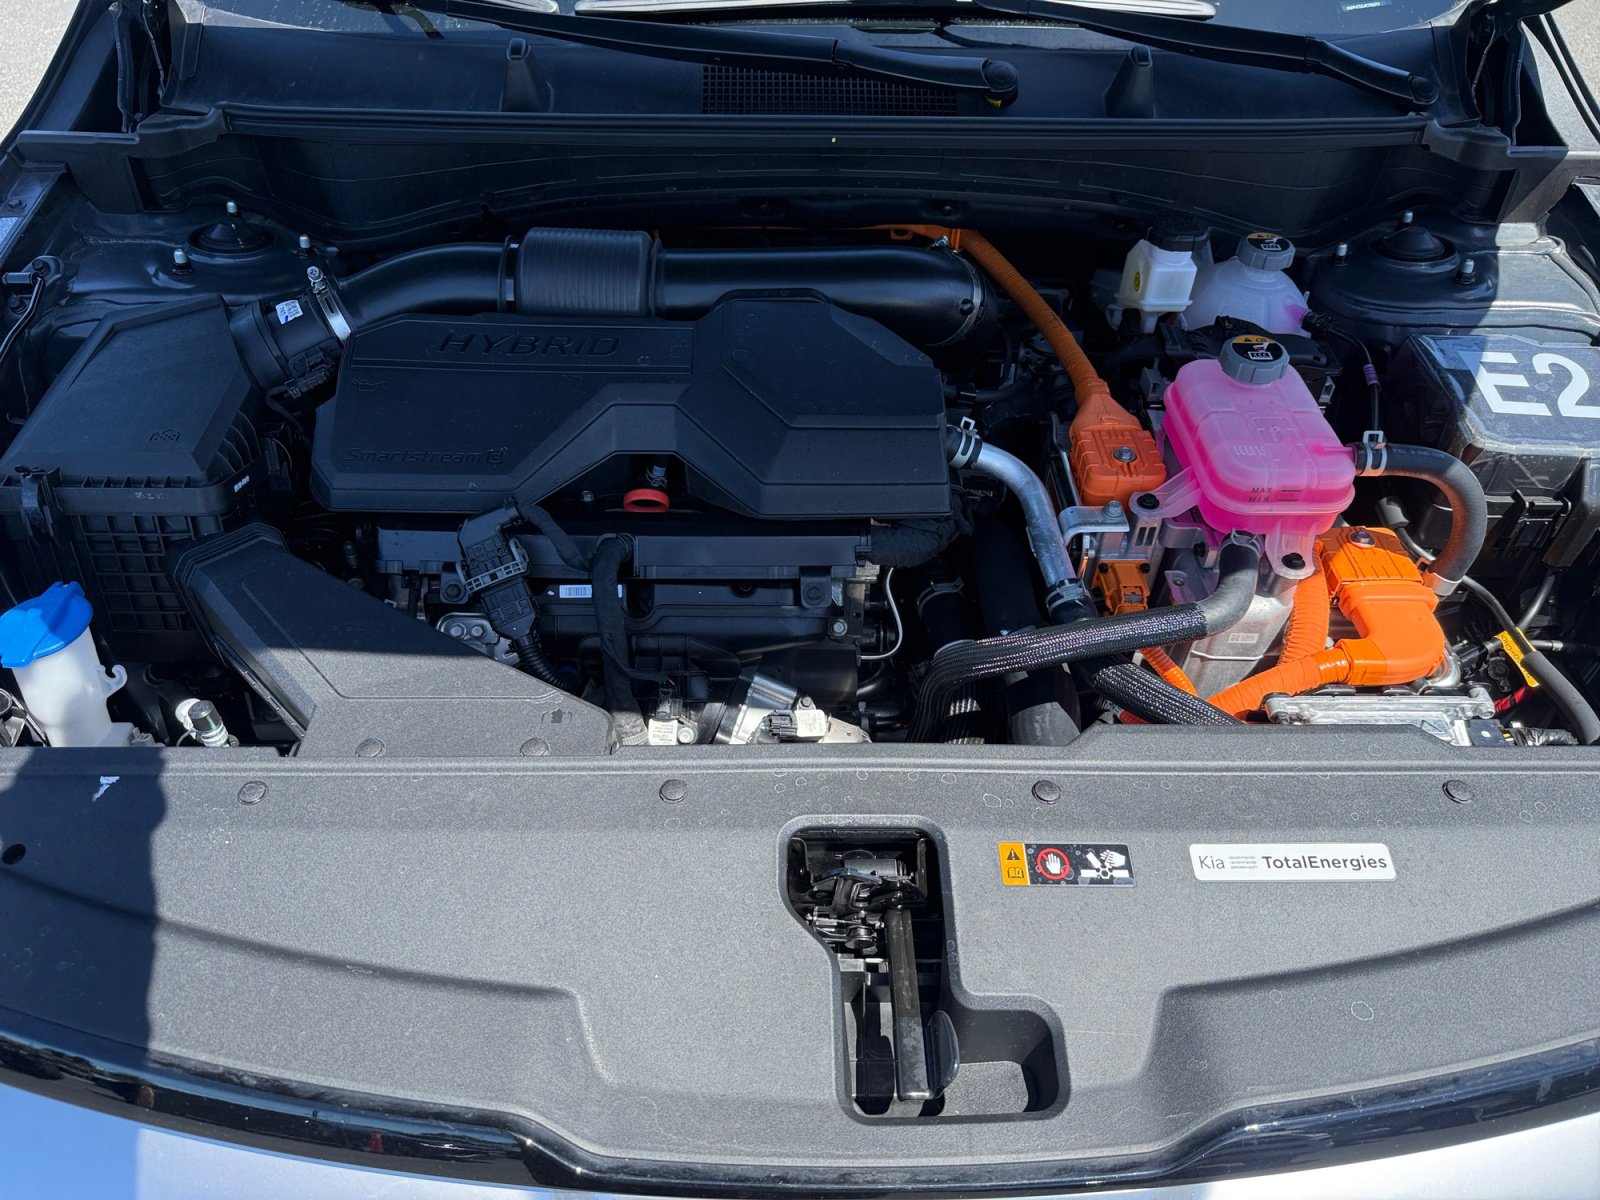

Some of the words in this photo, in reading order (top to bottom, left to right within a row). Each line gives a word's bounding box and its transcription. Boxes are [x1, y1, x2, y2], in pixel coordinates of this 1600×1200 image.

[437, 332, 622, 357] HYBRID
[1457, 351, 1600, 419] E2
[343, 447, 482, 464] Smartstream
[1198, 855, 1225, 870] Kia
[1261, 855, 1388, 872] TotalEnergies
